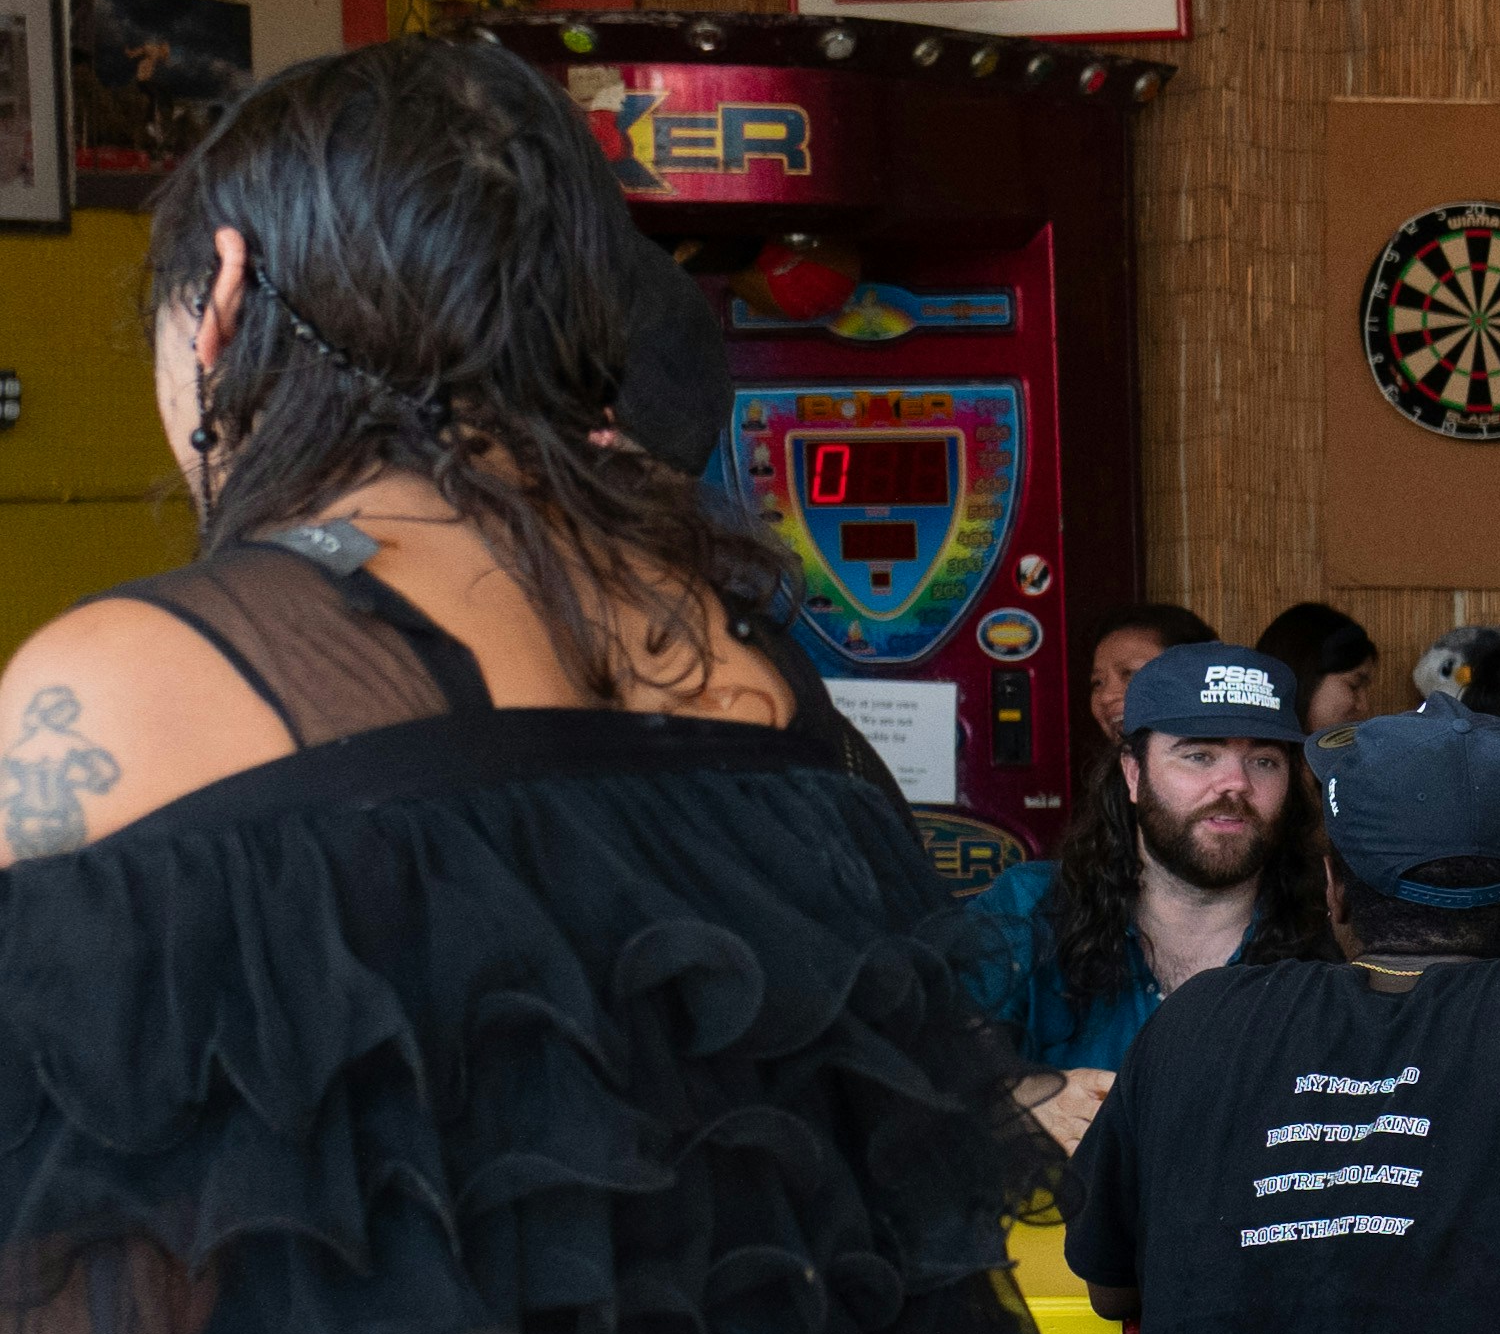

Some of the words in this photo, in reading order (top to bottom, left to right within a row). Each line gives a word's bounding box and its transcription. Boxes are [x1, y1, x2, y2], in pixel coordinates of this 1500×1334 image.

[811, 444, 850, 504] 0
[1200, 690, 1226, 703] CITY
[1227, 690, 1281, 711] CHAMPIONS
[1209, 680, 1273, 697] LACROSSE
[1295, 1073, 1329, 1096] MY
[1328, 1077, 1379, 1096] MOM
[1267, 1122, 1321, 1148] BORN
[1322, 1124, 1351, 1143] TO
[1374, 1113, 1430, 1137] KING
[1254, 1171, 1325, 1197] YOU'RE
[1363, 1165, 1423, 1188] LATE
[1241, 1222, 1298, 1248] ROCK
[1298, 1215, 1355, 1240] THAT
[1355, 1214, 1414, 1238] BODY
